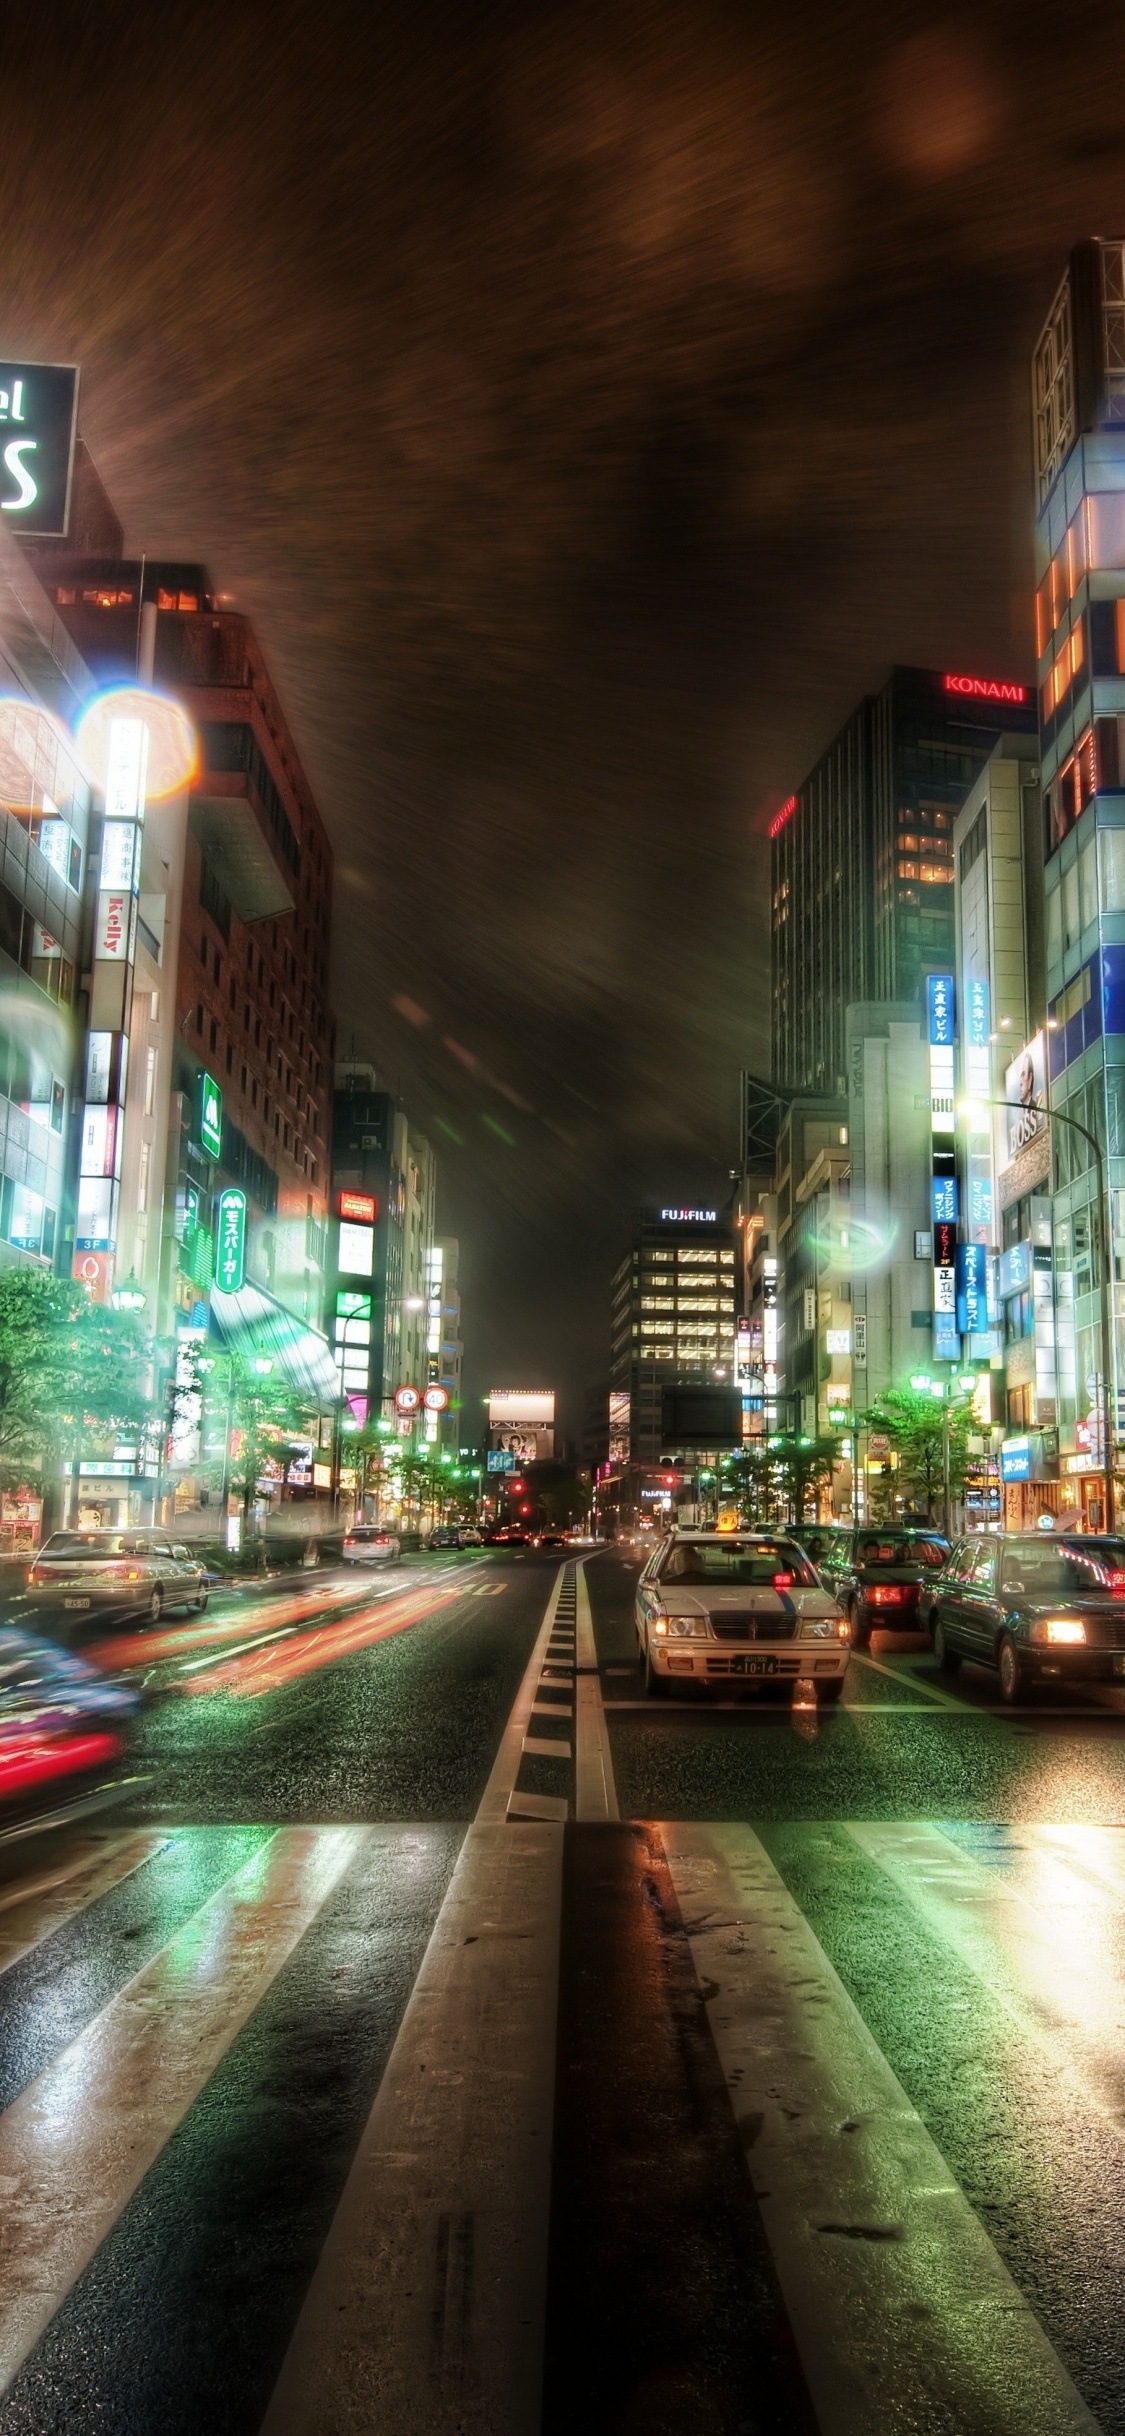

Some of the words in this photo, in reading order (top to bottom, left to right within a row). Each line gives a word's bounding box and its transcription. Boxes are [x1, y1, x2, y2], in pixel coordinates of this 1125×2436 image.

[945, 675, 1024, 702] KONAMI
[104, 898, 123, 953] Kelly
[933, 980, 948, 1042] 正直家ビル
[1009, 1110, 1037, 1154] BOSS
[935, 1192, 944, 1220] ポイント
[943, 1180, 954, 1220] ヴァニシング
[661, 1207, 717, 1222] FUJIFILM
[83, 1240, 101, 1250] 3F
[223, 1210, 241, 1286] モスバーガー
[965, 1246, 978, 1331] スペーストラスト
[855, 1324, 865, 1348] 阿里山
[428, 1394, 442, 1405] 40
[744, 1662, 774, 1674] 10-14
